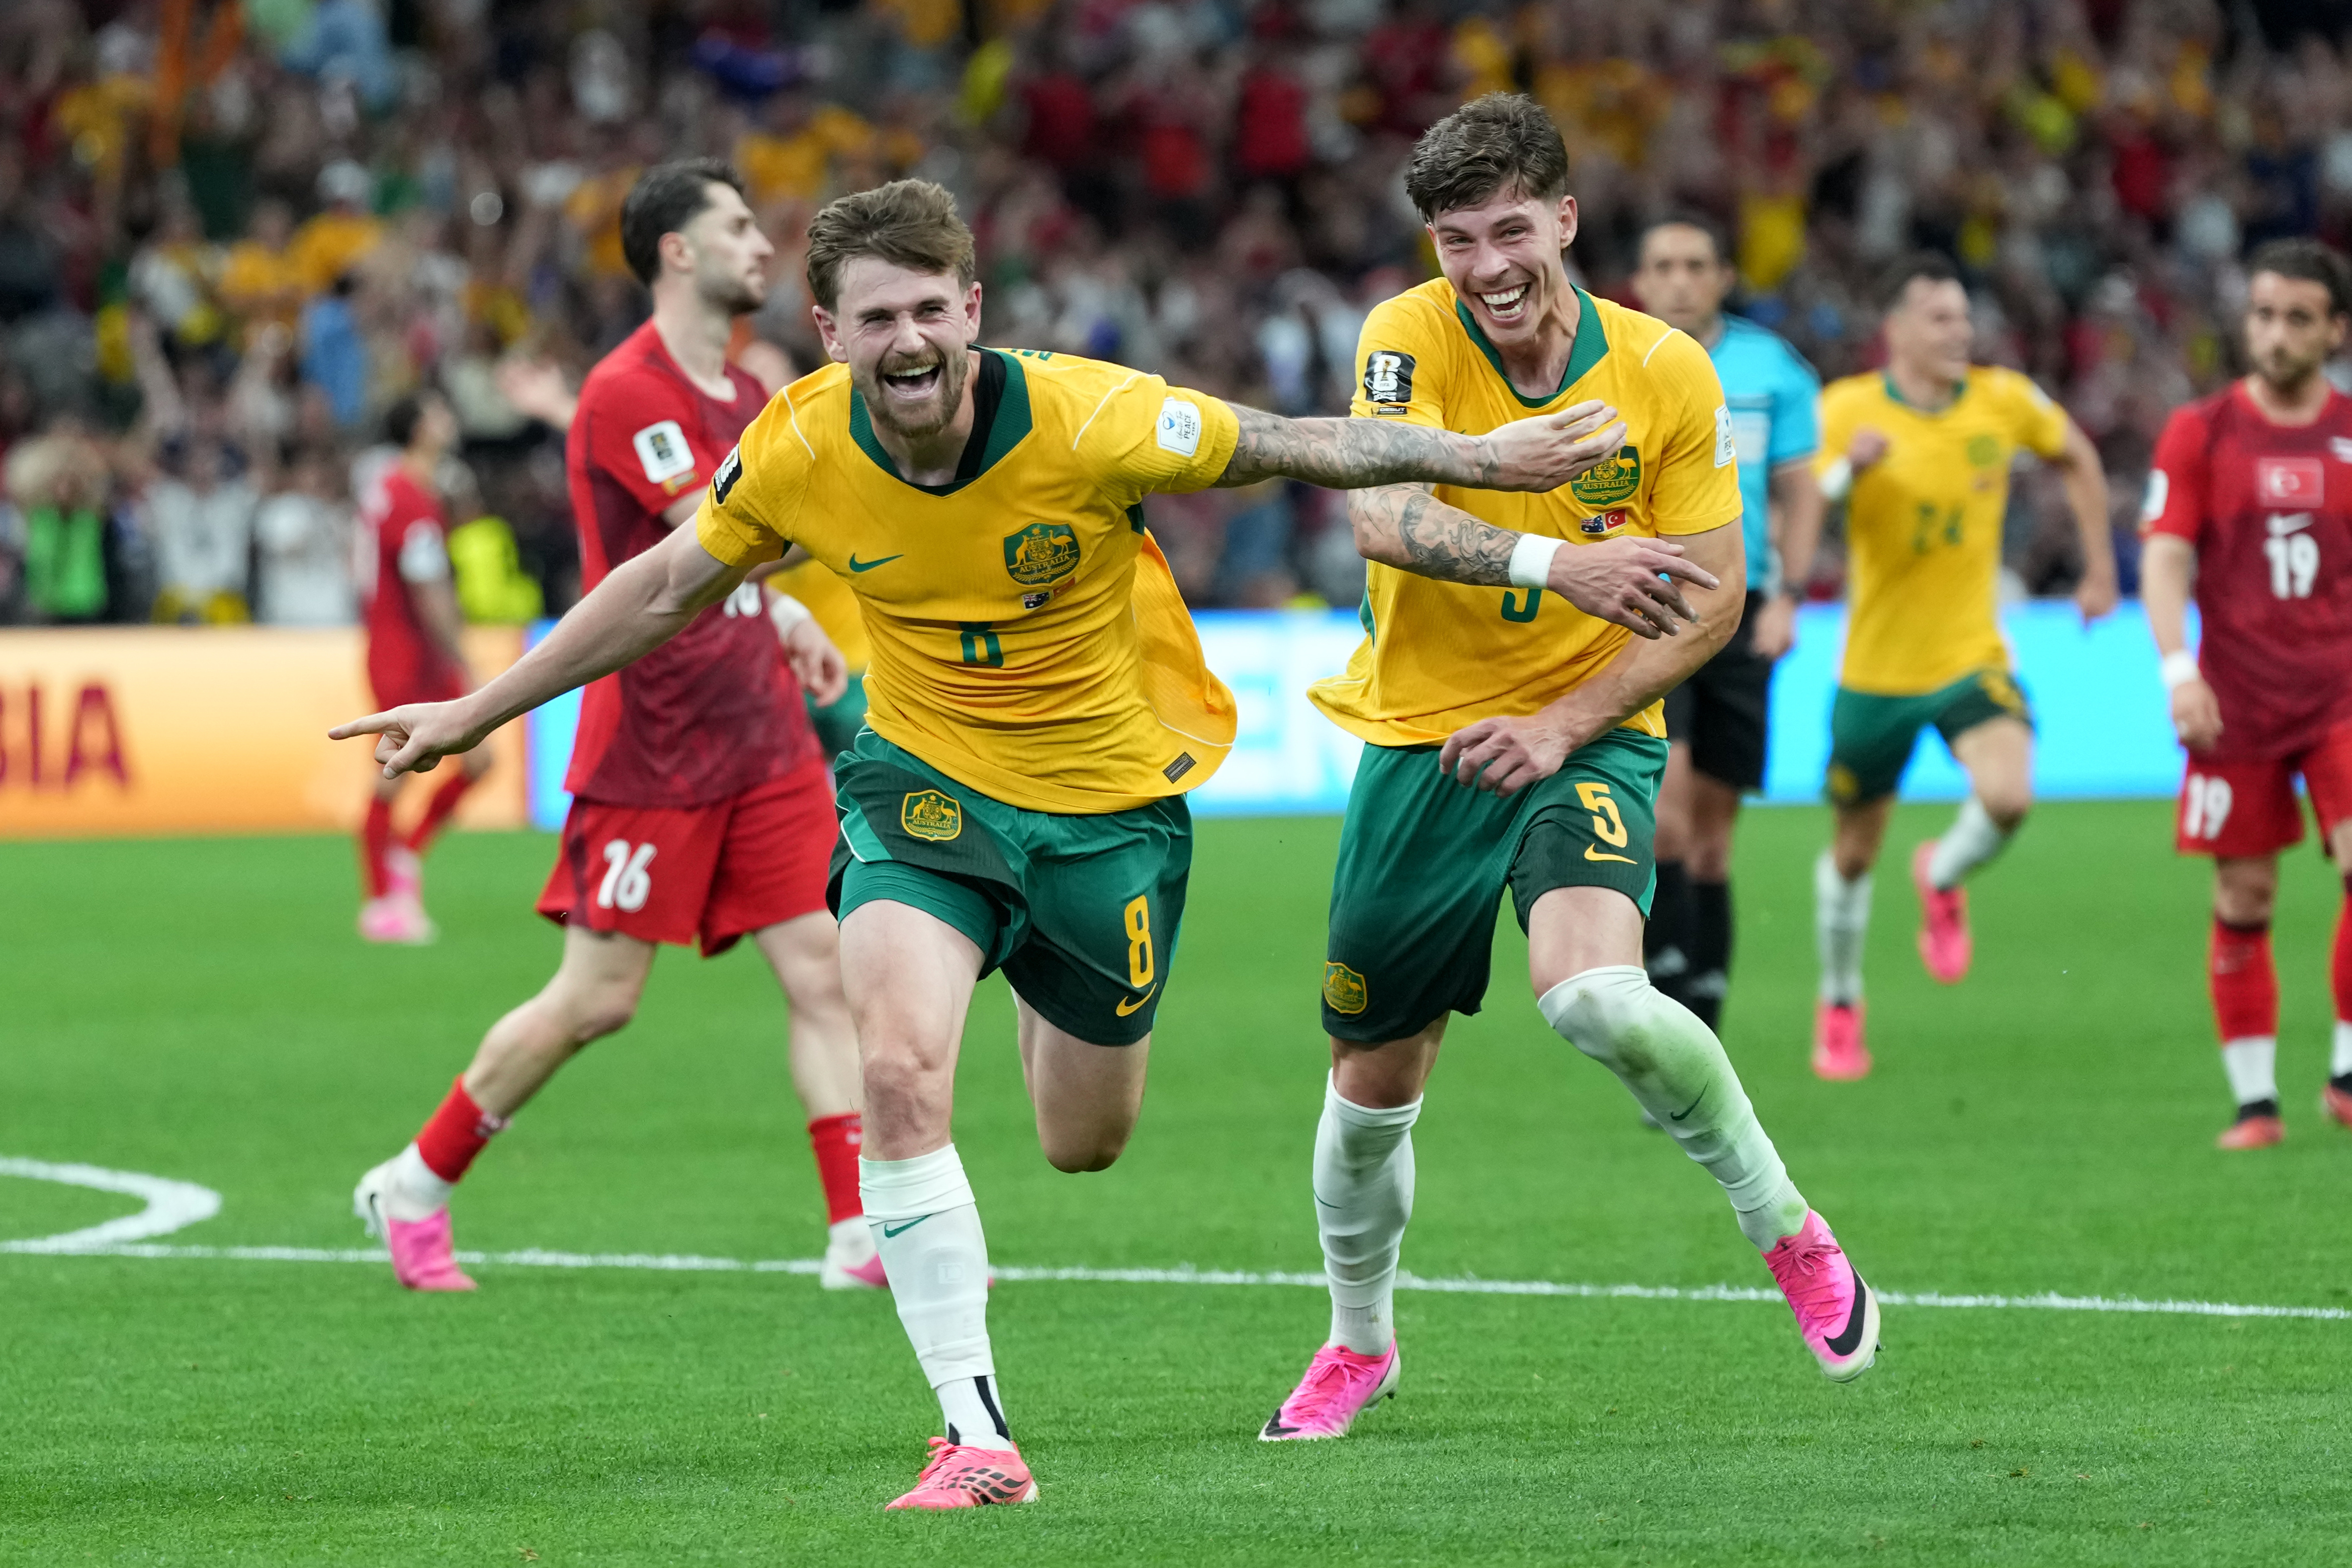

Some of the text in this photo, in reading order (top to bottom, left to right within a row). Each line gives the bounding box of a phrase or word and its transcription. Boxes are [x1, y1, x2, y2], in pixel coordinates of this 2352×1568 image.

[1582, 480, 1629, 490] AUSTRALIA
[1020, 555, 1070, 573] AUSTRALIA
[2263, 532, 2321, 600] 19
[0, 684, 130, 790] IA
[913, 820, 951, 829] AUSTRALIA
[1574, 783, 1628, 848] 5
[2185, 773, 2233, 840] 19
[598, 838, 658, 913] 16
[1125, 895, 1154, 988] 8
